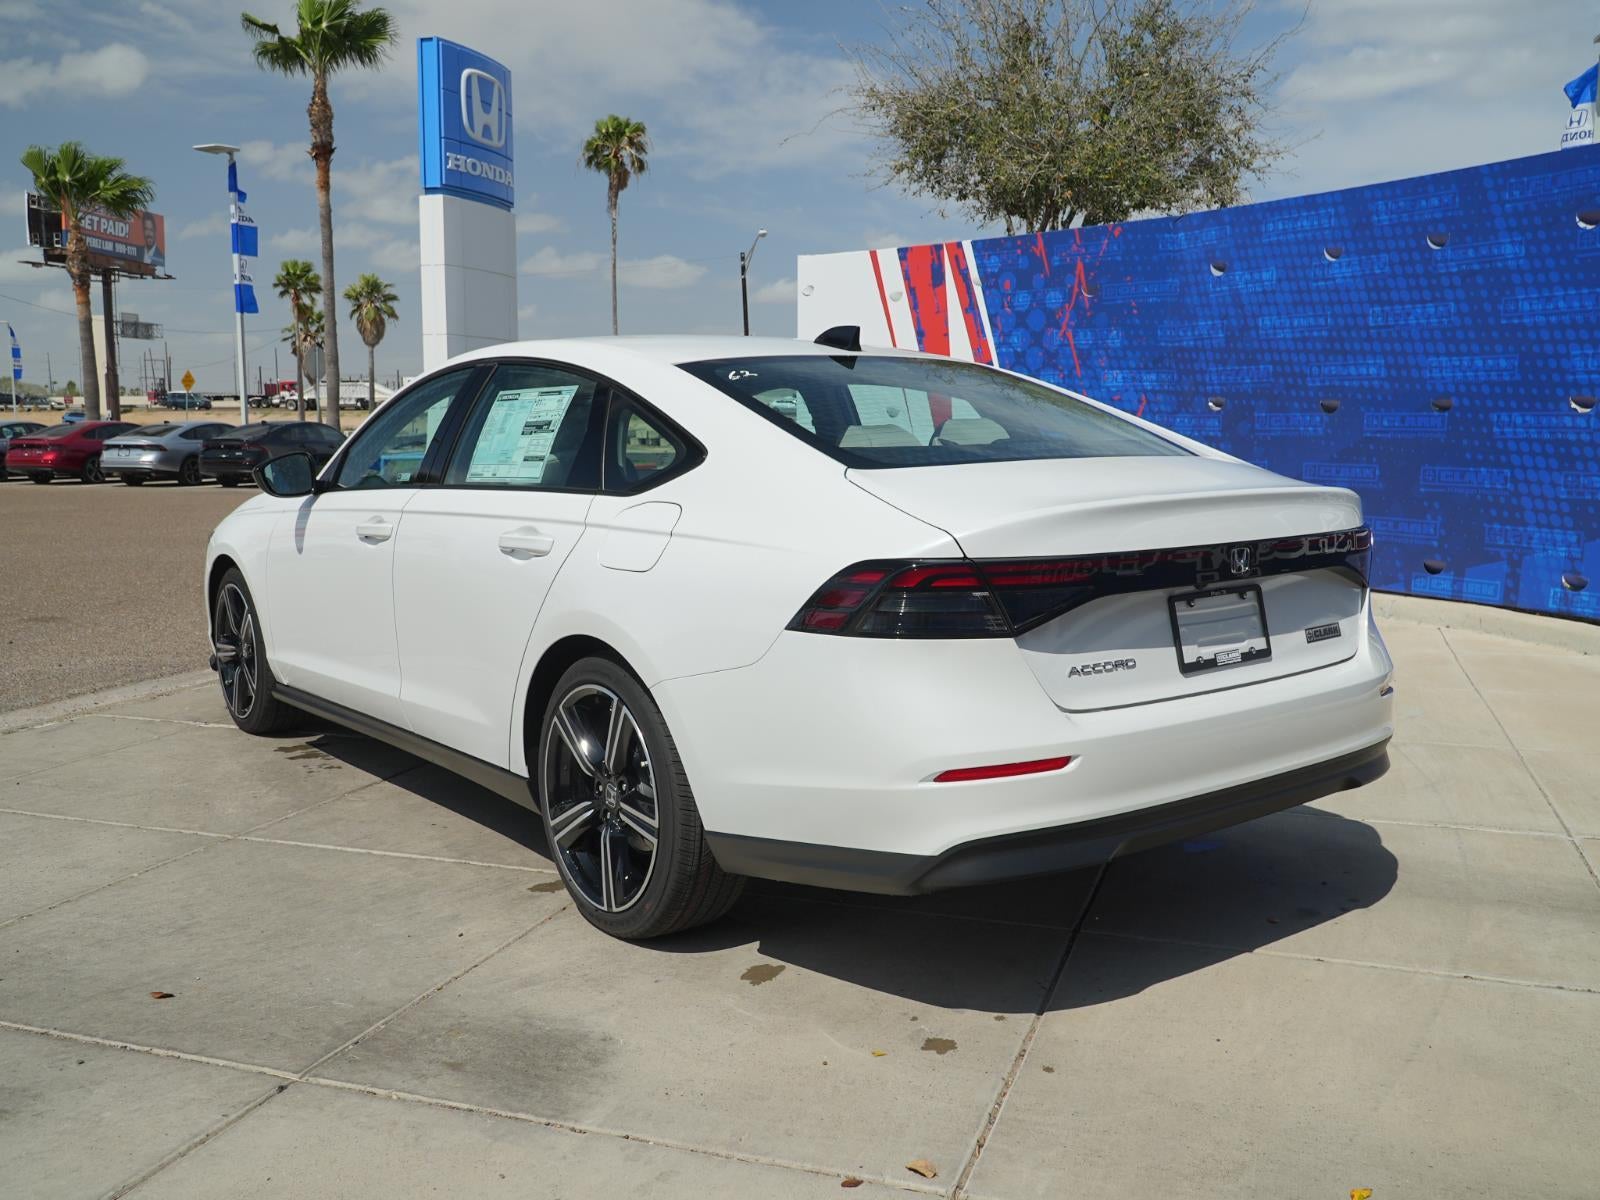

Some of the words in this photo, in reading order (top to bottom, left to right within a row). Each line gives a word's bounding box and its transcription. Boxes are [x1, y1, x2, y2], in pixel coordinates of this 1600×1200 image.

[446, 151, 514, 187] HONDA
[100, 217, 129, 239] PAID!
[1068, 658, 1137, 678] ACCORD
